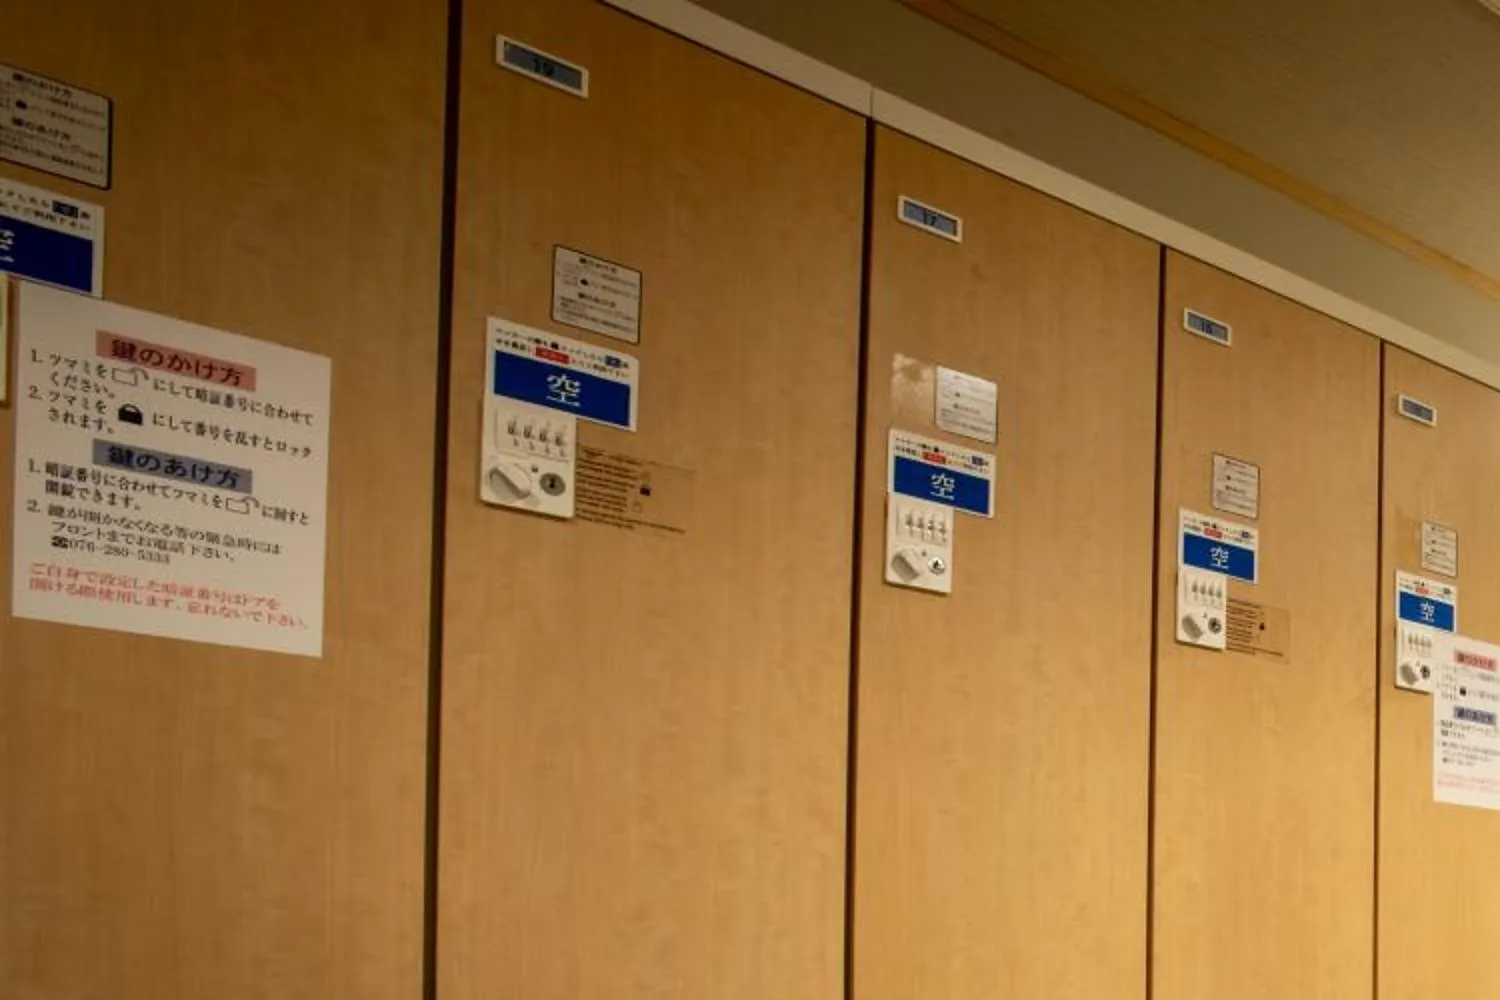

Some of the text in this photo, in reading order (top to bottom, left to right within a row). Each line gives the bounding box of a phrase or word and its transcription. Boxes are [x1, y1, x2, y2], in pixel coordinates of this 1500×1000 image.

[111, 339, 242, 386] 鍵のかけ方
[545, 373, 582, 407] 空
[107, 445, 240, 488] 鍵のあけ方
[930, 472, 956, 501] 空
[1209, 546, 1230, 570] 空
[1420, 602, 1435, 624] 空
